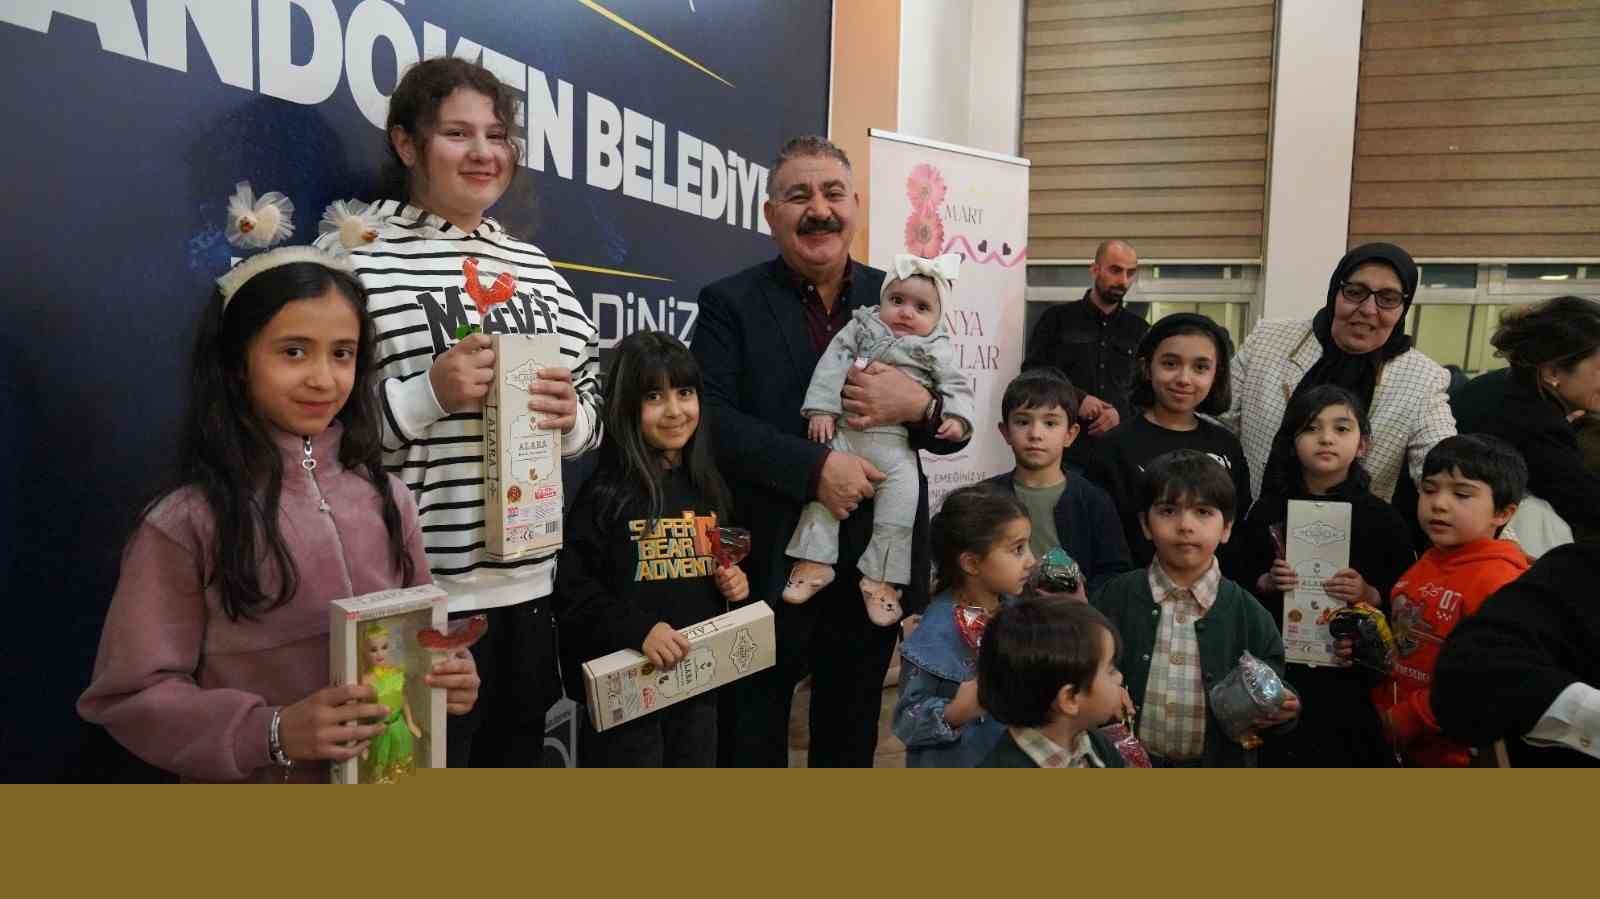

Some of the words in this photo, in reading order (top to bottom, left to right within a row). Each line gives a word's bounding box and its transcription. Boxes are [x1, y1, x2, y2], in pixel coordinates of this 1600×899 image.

[944, 204, 984, 224] MART
[944, 310, 984, 336] NYA
[954, 343, 1000, 370] LAR
[628, 517, 696, 540] SUPER
[638, 537, 695, 560] BEAR
[634, 556, 714, 582] ADVENT
